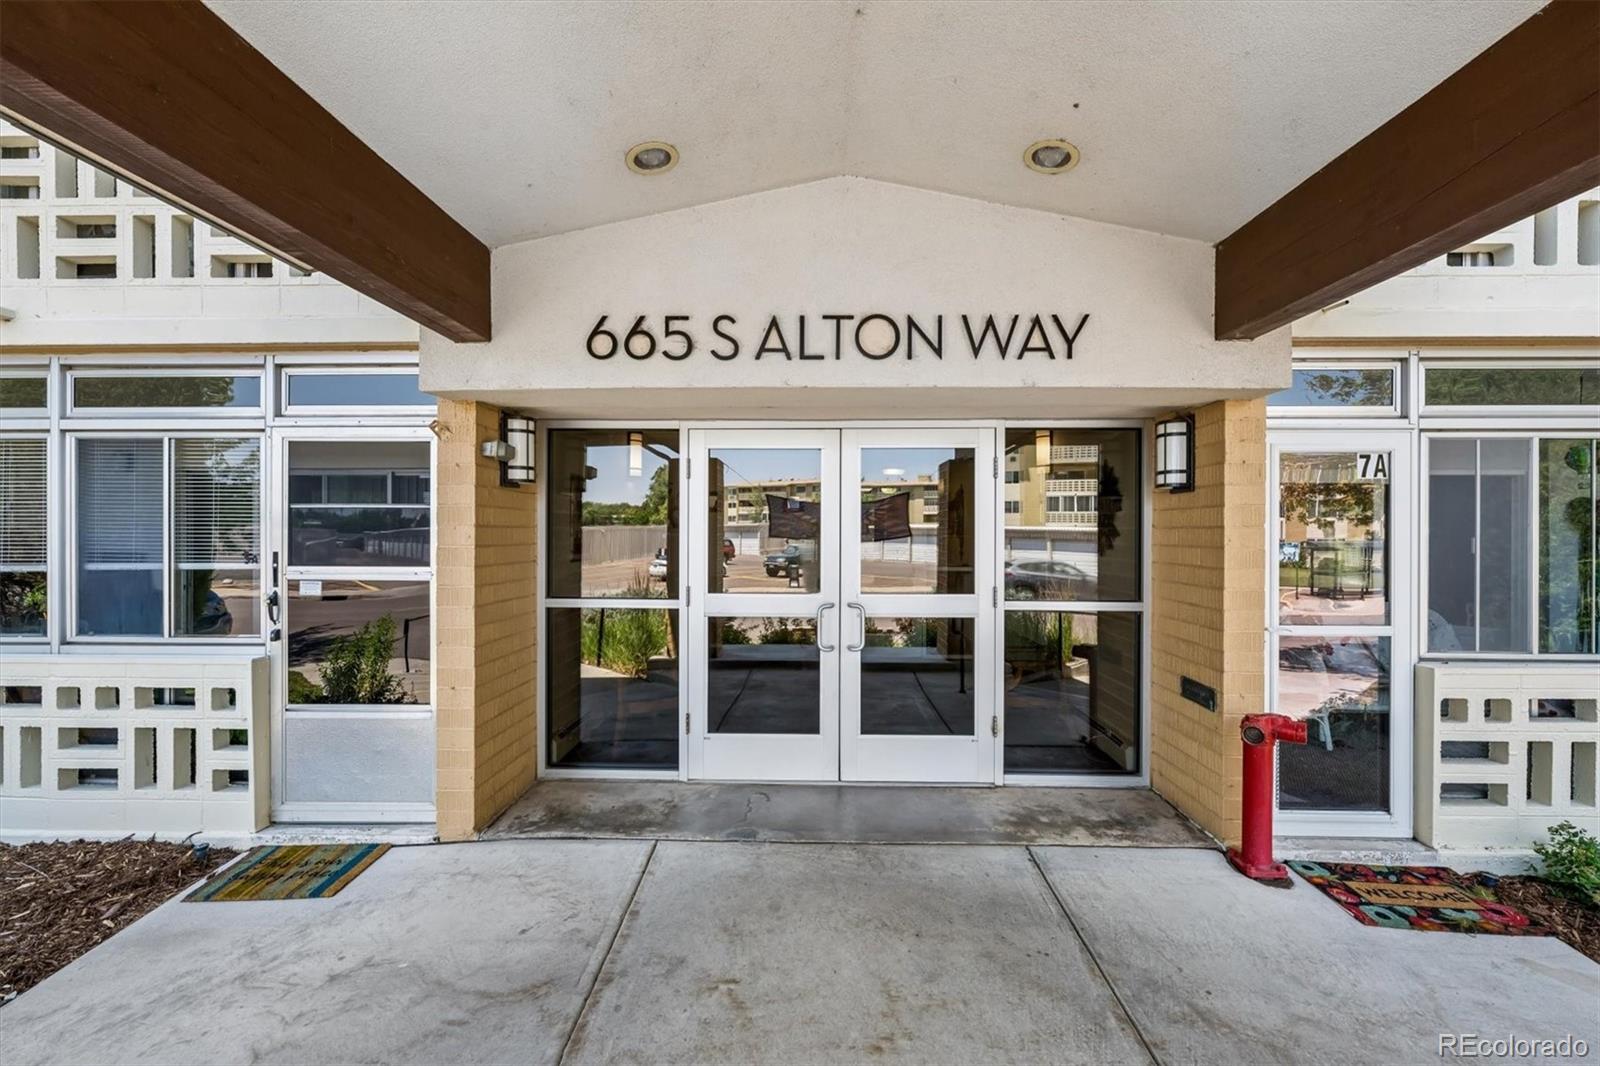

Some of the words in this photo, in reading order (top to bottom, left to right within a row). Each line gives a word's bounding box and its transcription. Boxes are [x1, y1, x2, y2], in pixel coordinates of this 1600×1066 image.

[586, 314, 694, 360] 665
[711, 314, 740, 360] S
[755, 314, 943, 360] ALTON
[961, 314, 1090, 360] WAY
[1359, 454, 1387, 478] 7A
[1357, 886, 1471, 903] WELCOME
